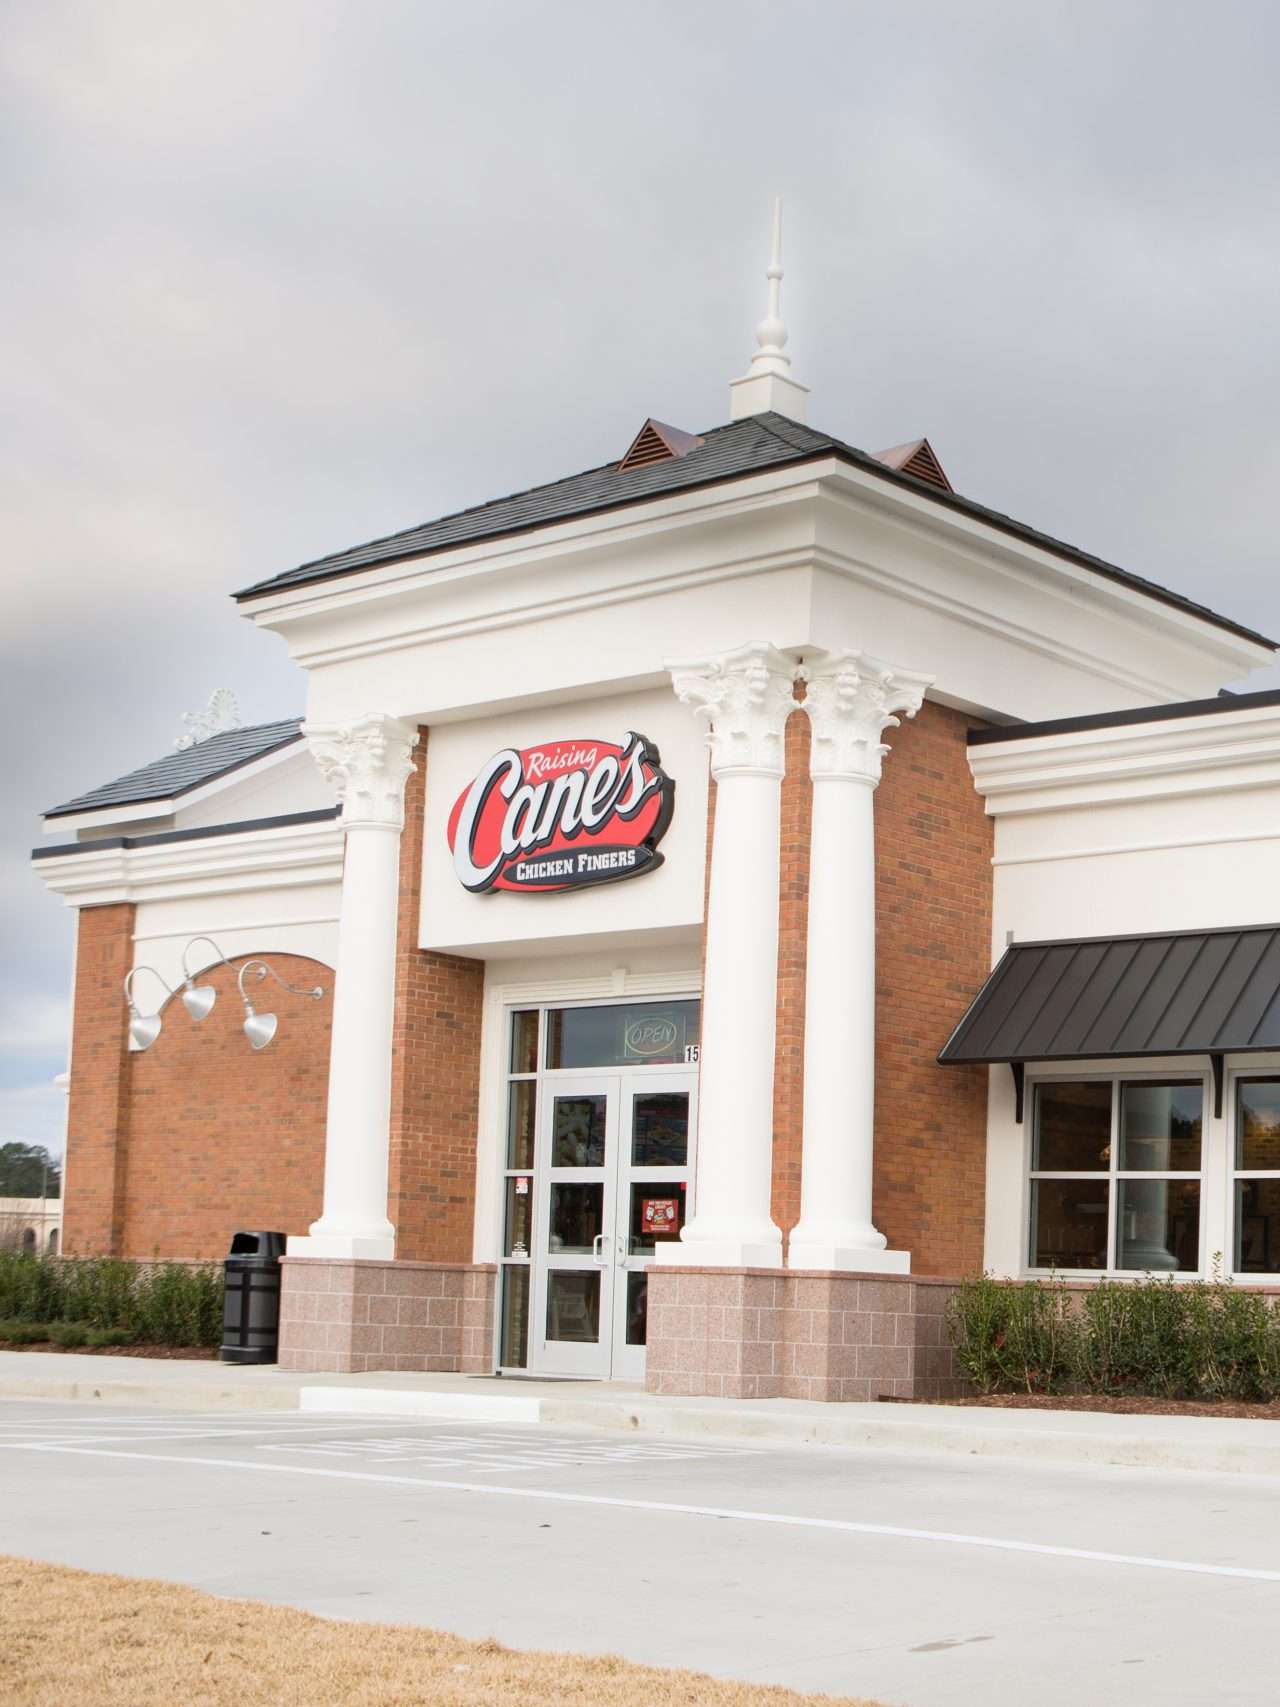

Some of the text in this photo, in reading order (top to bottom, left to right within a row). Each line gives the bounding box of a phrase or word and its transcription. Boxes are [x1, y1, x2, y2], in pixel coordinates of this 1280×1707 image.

[526, 745, 598, 779] Raising
[454, 732, 663, 887] Cane's
[516, 849, 636, 881] CHICKEN FINGERS
[631, 1024, 673, 1045] OPEN
